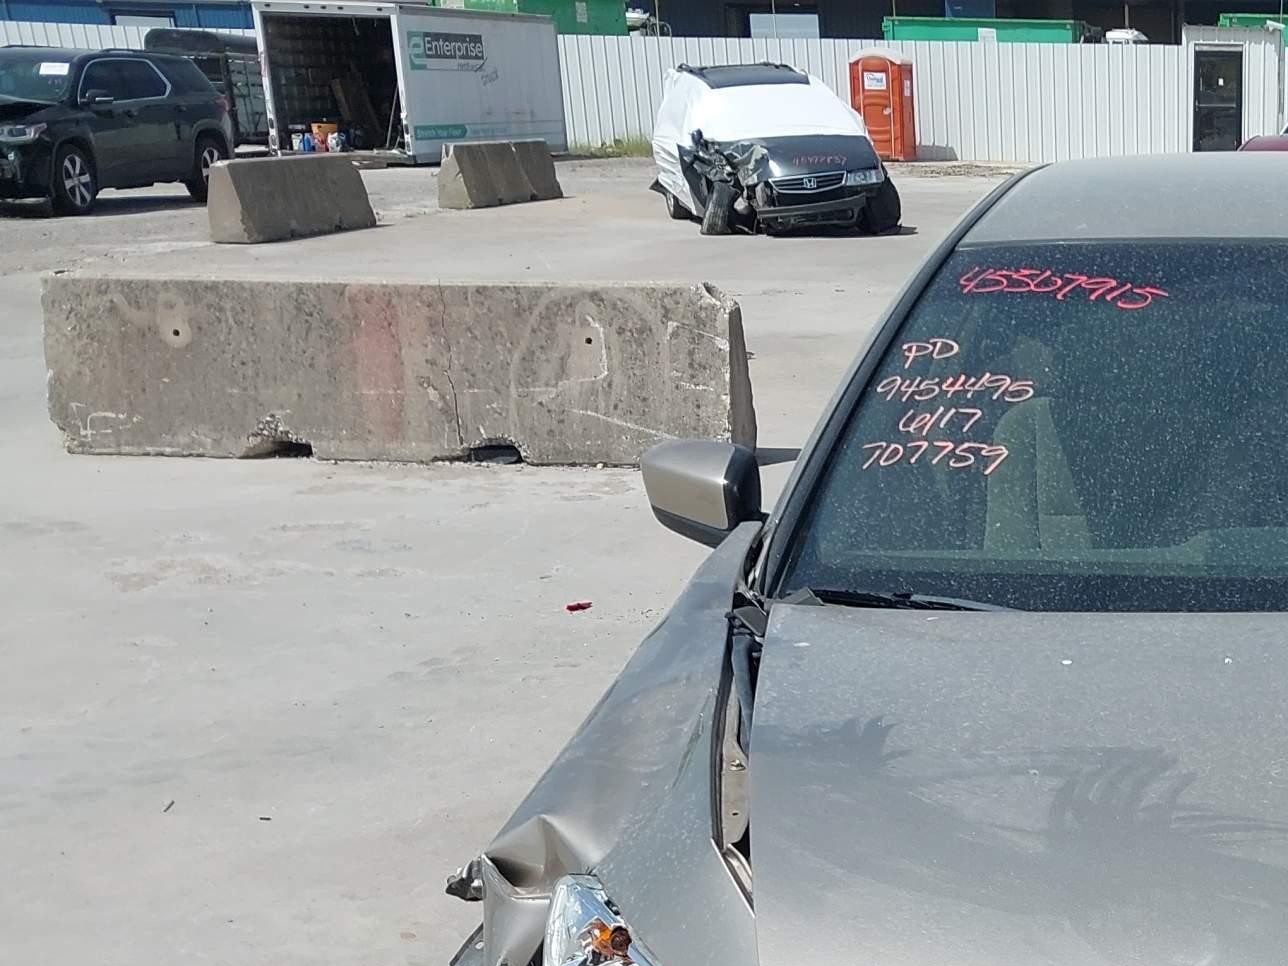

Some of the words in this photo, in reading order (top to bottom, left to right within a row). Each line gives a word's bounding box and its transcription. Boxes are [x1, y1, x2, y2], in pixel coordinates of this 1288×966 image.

[424, 36, 483, 60] Enterprise
[901, 338, 960, 369] PD
[876, 372, 1035, 403] 9454495
[861, 440, 1009, 475] 707759
